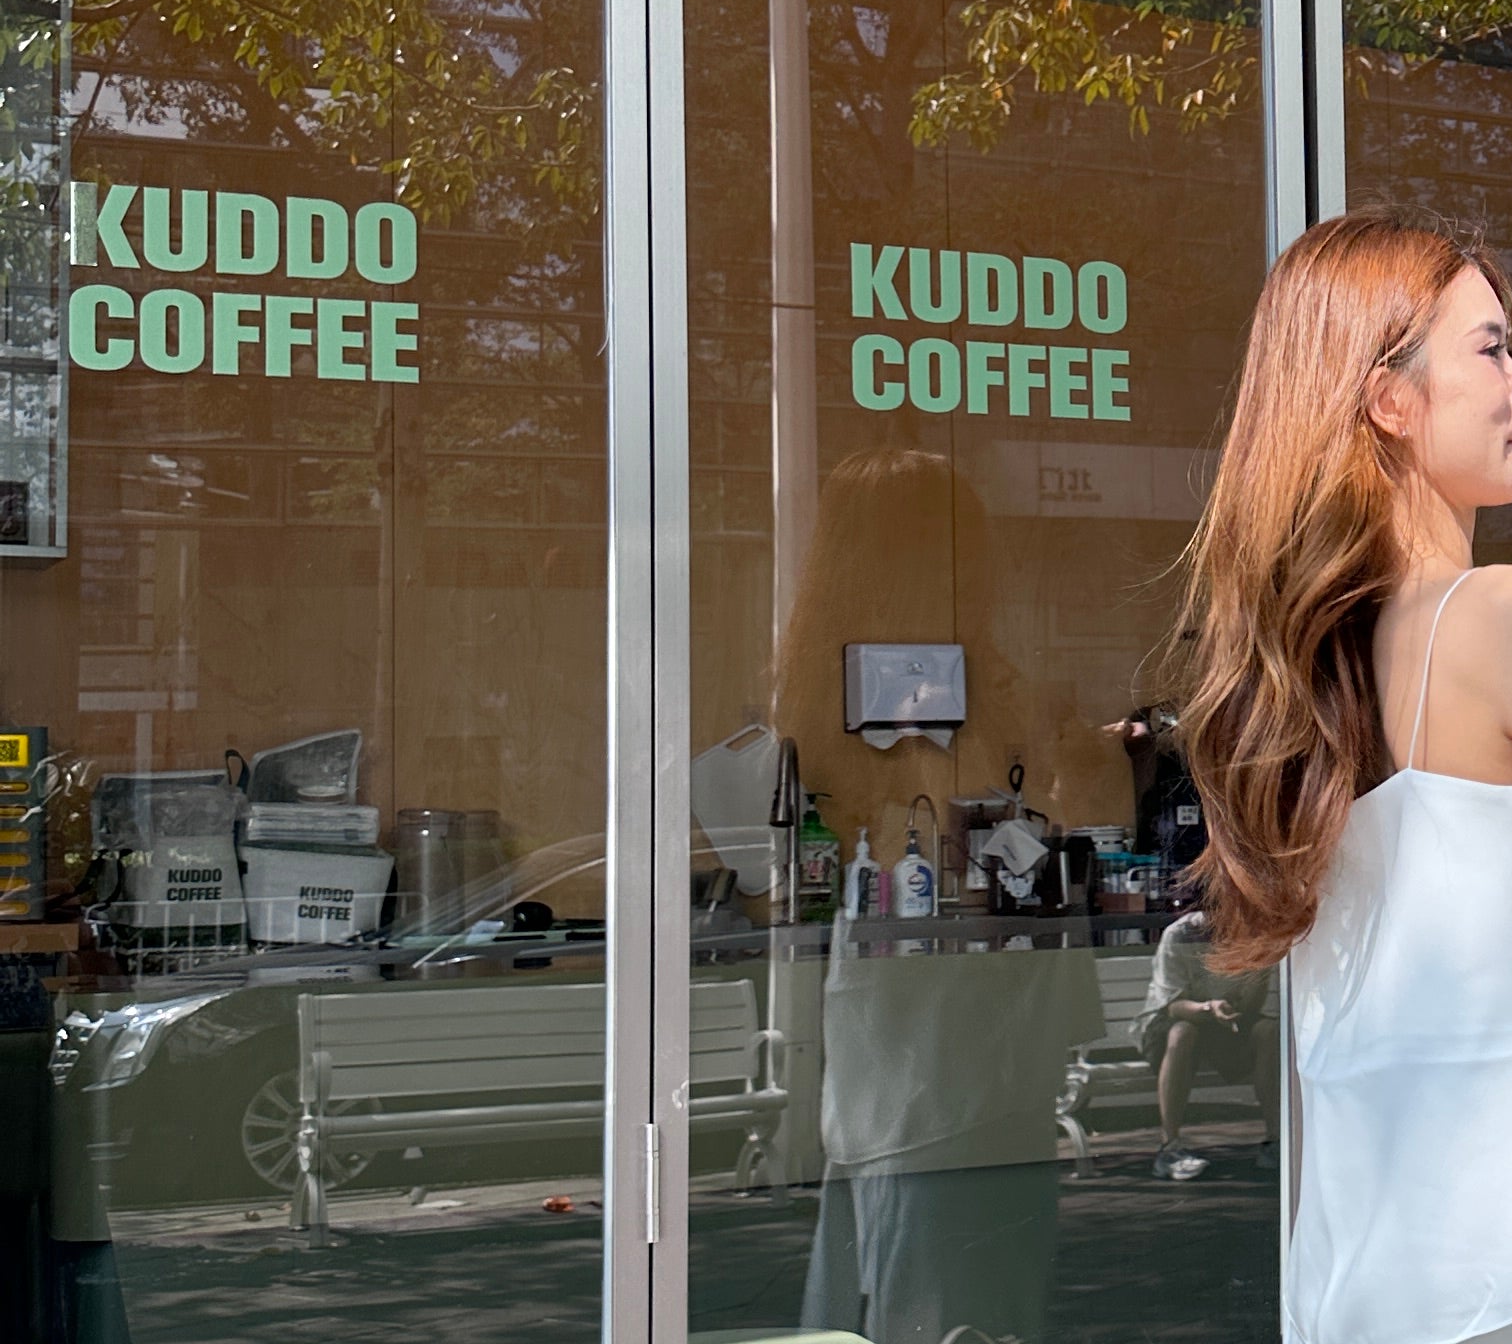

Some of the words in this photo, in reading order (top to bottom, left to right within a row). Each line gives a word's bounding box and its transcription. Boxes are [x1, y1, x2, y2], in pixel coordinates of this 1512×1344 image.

[70, 181, 417, 284] KUDDO
[850, 242, 1127, 333] KUDDO
[68, 285, 420, 384] COFFEE
[851, 334, 1131, 421] COFFEE
[166, 886, 222, 902] COFFEE
[167, 867, 223, 884] KUDDO
[298, 885, 355, 904] KUDDO
[297, 903, 353, 922] COFFEE
